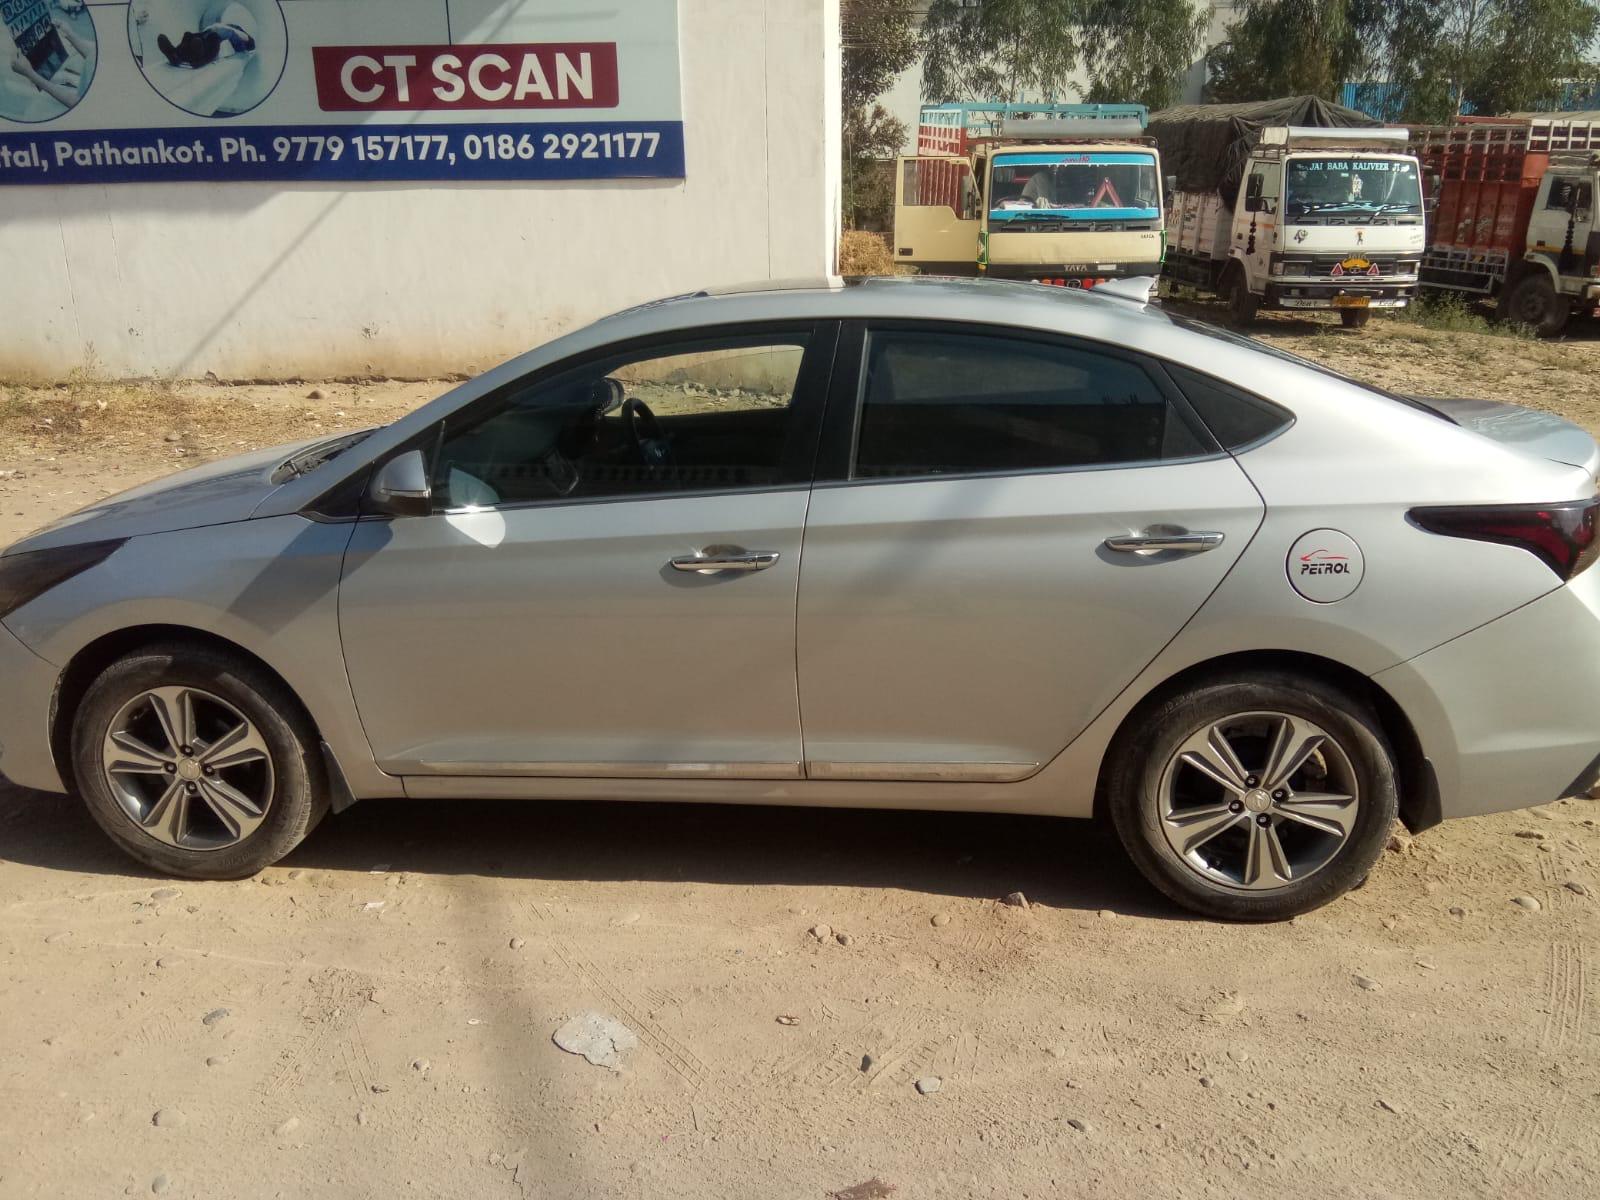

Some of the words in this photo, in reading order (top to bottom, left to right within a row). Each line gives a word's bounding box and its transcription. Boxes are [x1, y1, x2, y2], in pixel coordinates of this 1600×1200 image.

[340, 54, 417, 103] CT
[431, 52, 594, 102] SCAN
[0, 142, 49, 172] tal,
[54, 138, 213, 166] Pathankot.
[220, 137, 266, 162] Ph.
[273, 135, 344, 161] 9779
[351, 135, 456, 165] 157177,
[463, 133, 535, 160] 0186
[542, 132, 661, 159] 2921177
[1327, 162, 1349, 171] BABA
[1063, 264, 1088, 272] TATA
[1300, 562, 1350, 575] PETROL
